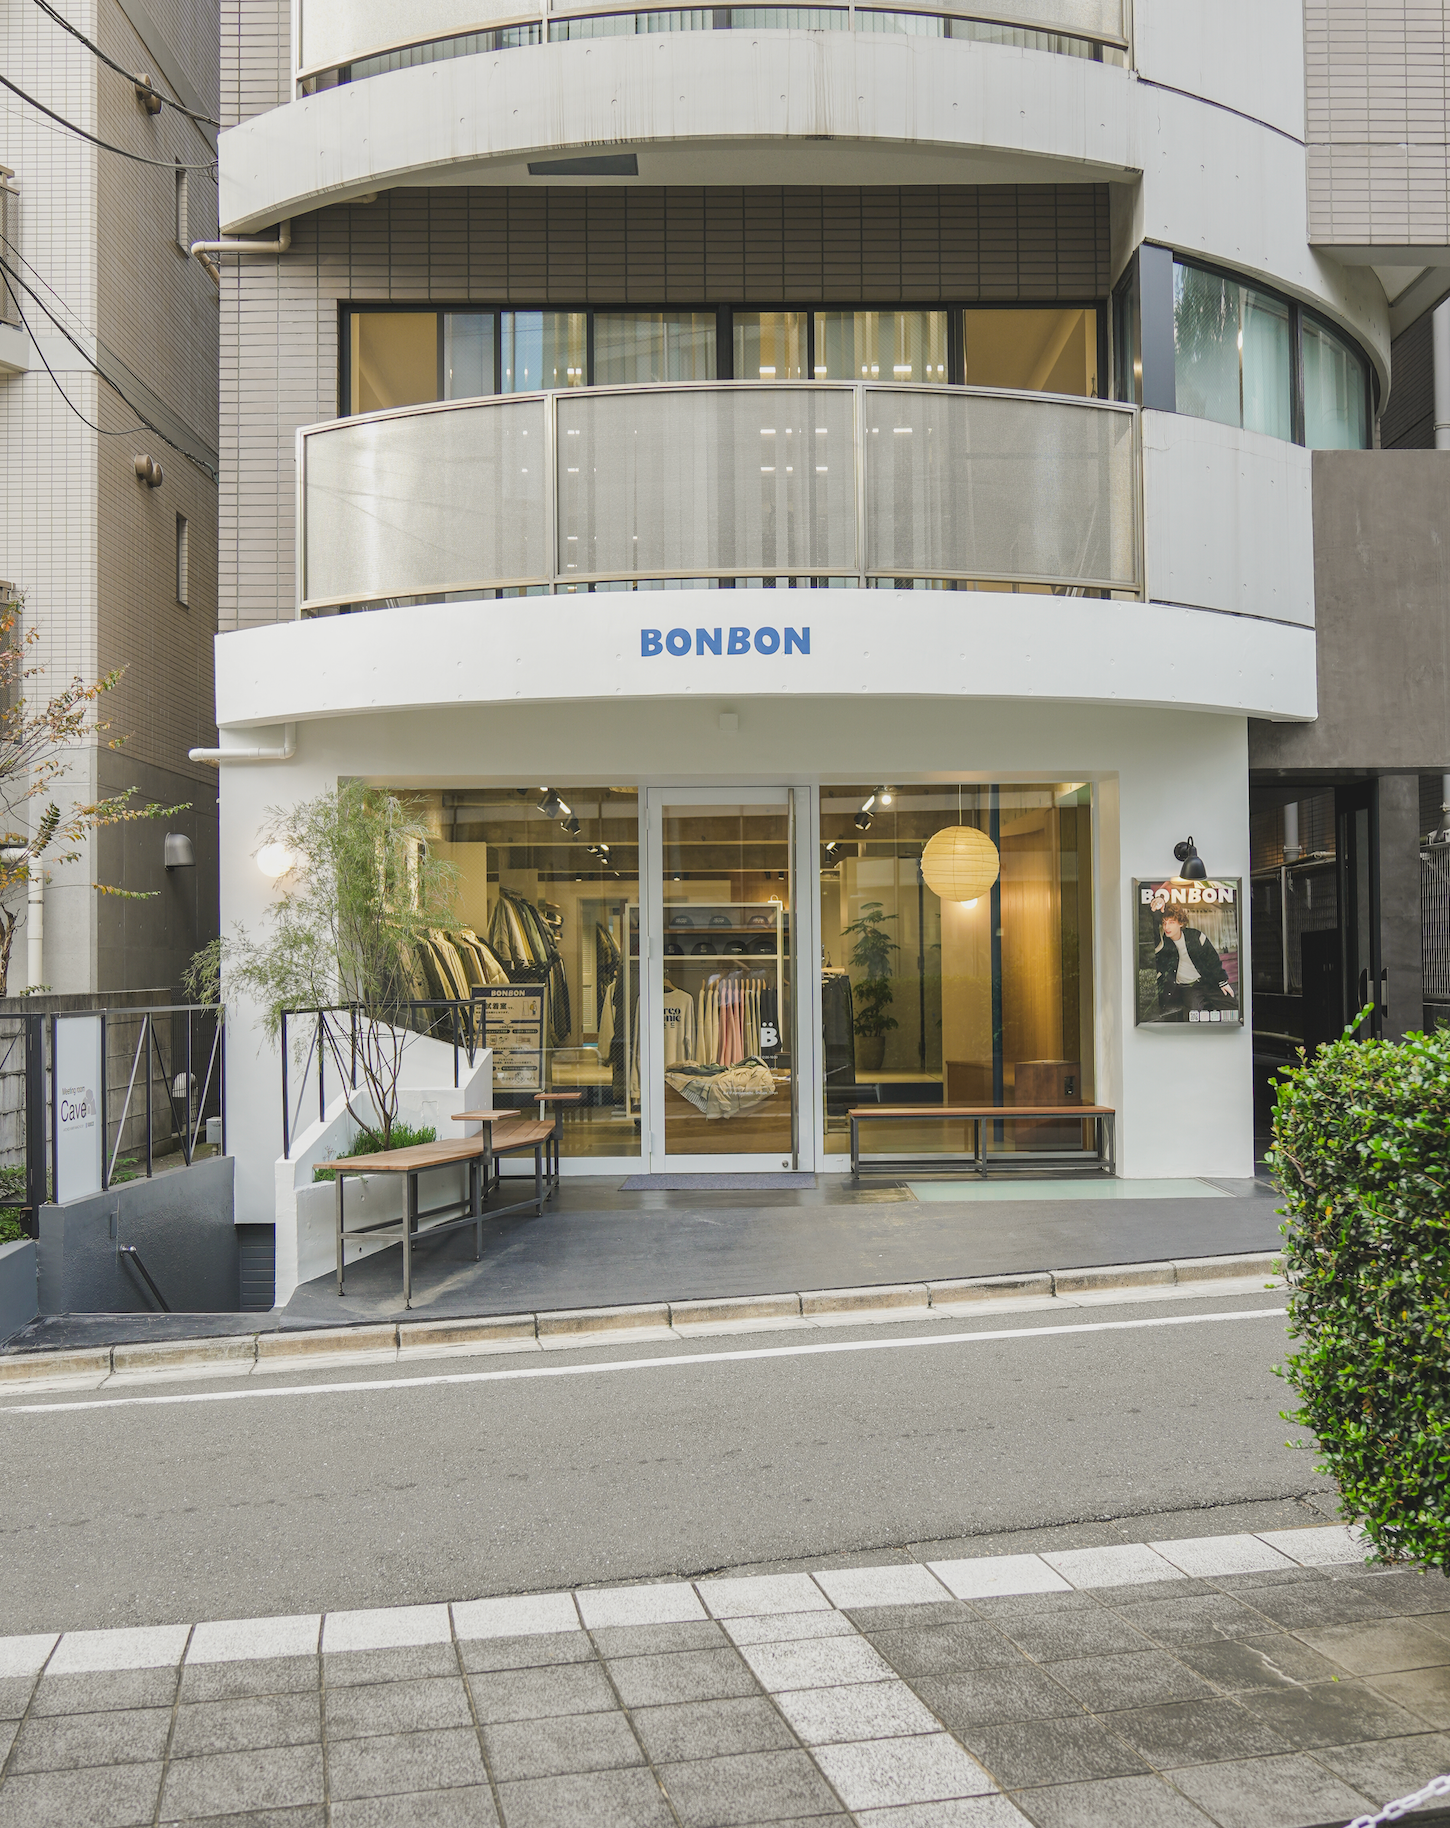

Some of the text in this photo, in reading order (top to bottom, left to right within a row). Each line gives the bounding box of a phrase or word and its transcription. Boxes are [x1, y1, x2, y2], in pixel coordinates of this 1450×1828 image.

[640, 626, 811, 657] BONBON
[1141, 887, 1234, 904] BONBON
[663, 1007, 681, 1015] reo
[663, 1013, 681, 1022] nic
[62, 1087, 76, 1095] Meeting
[61, 1100, 86, 1122] Cave
